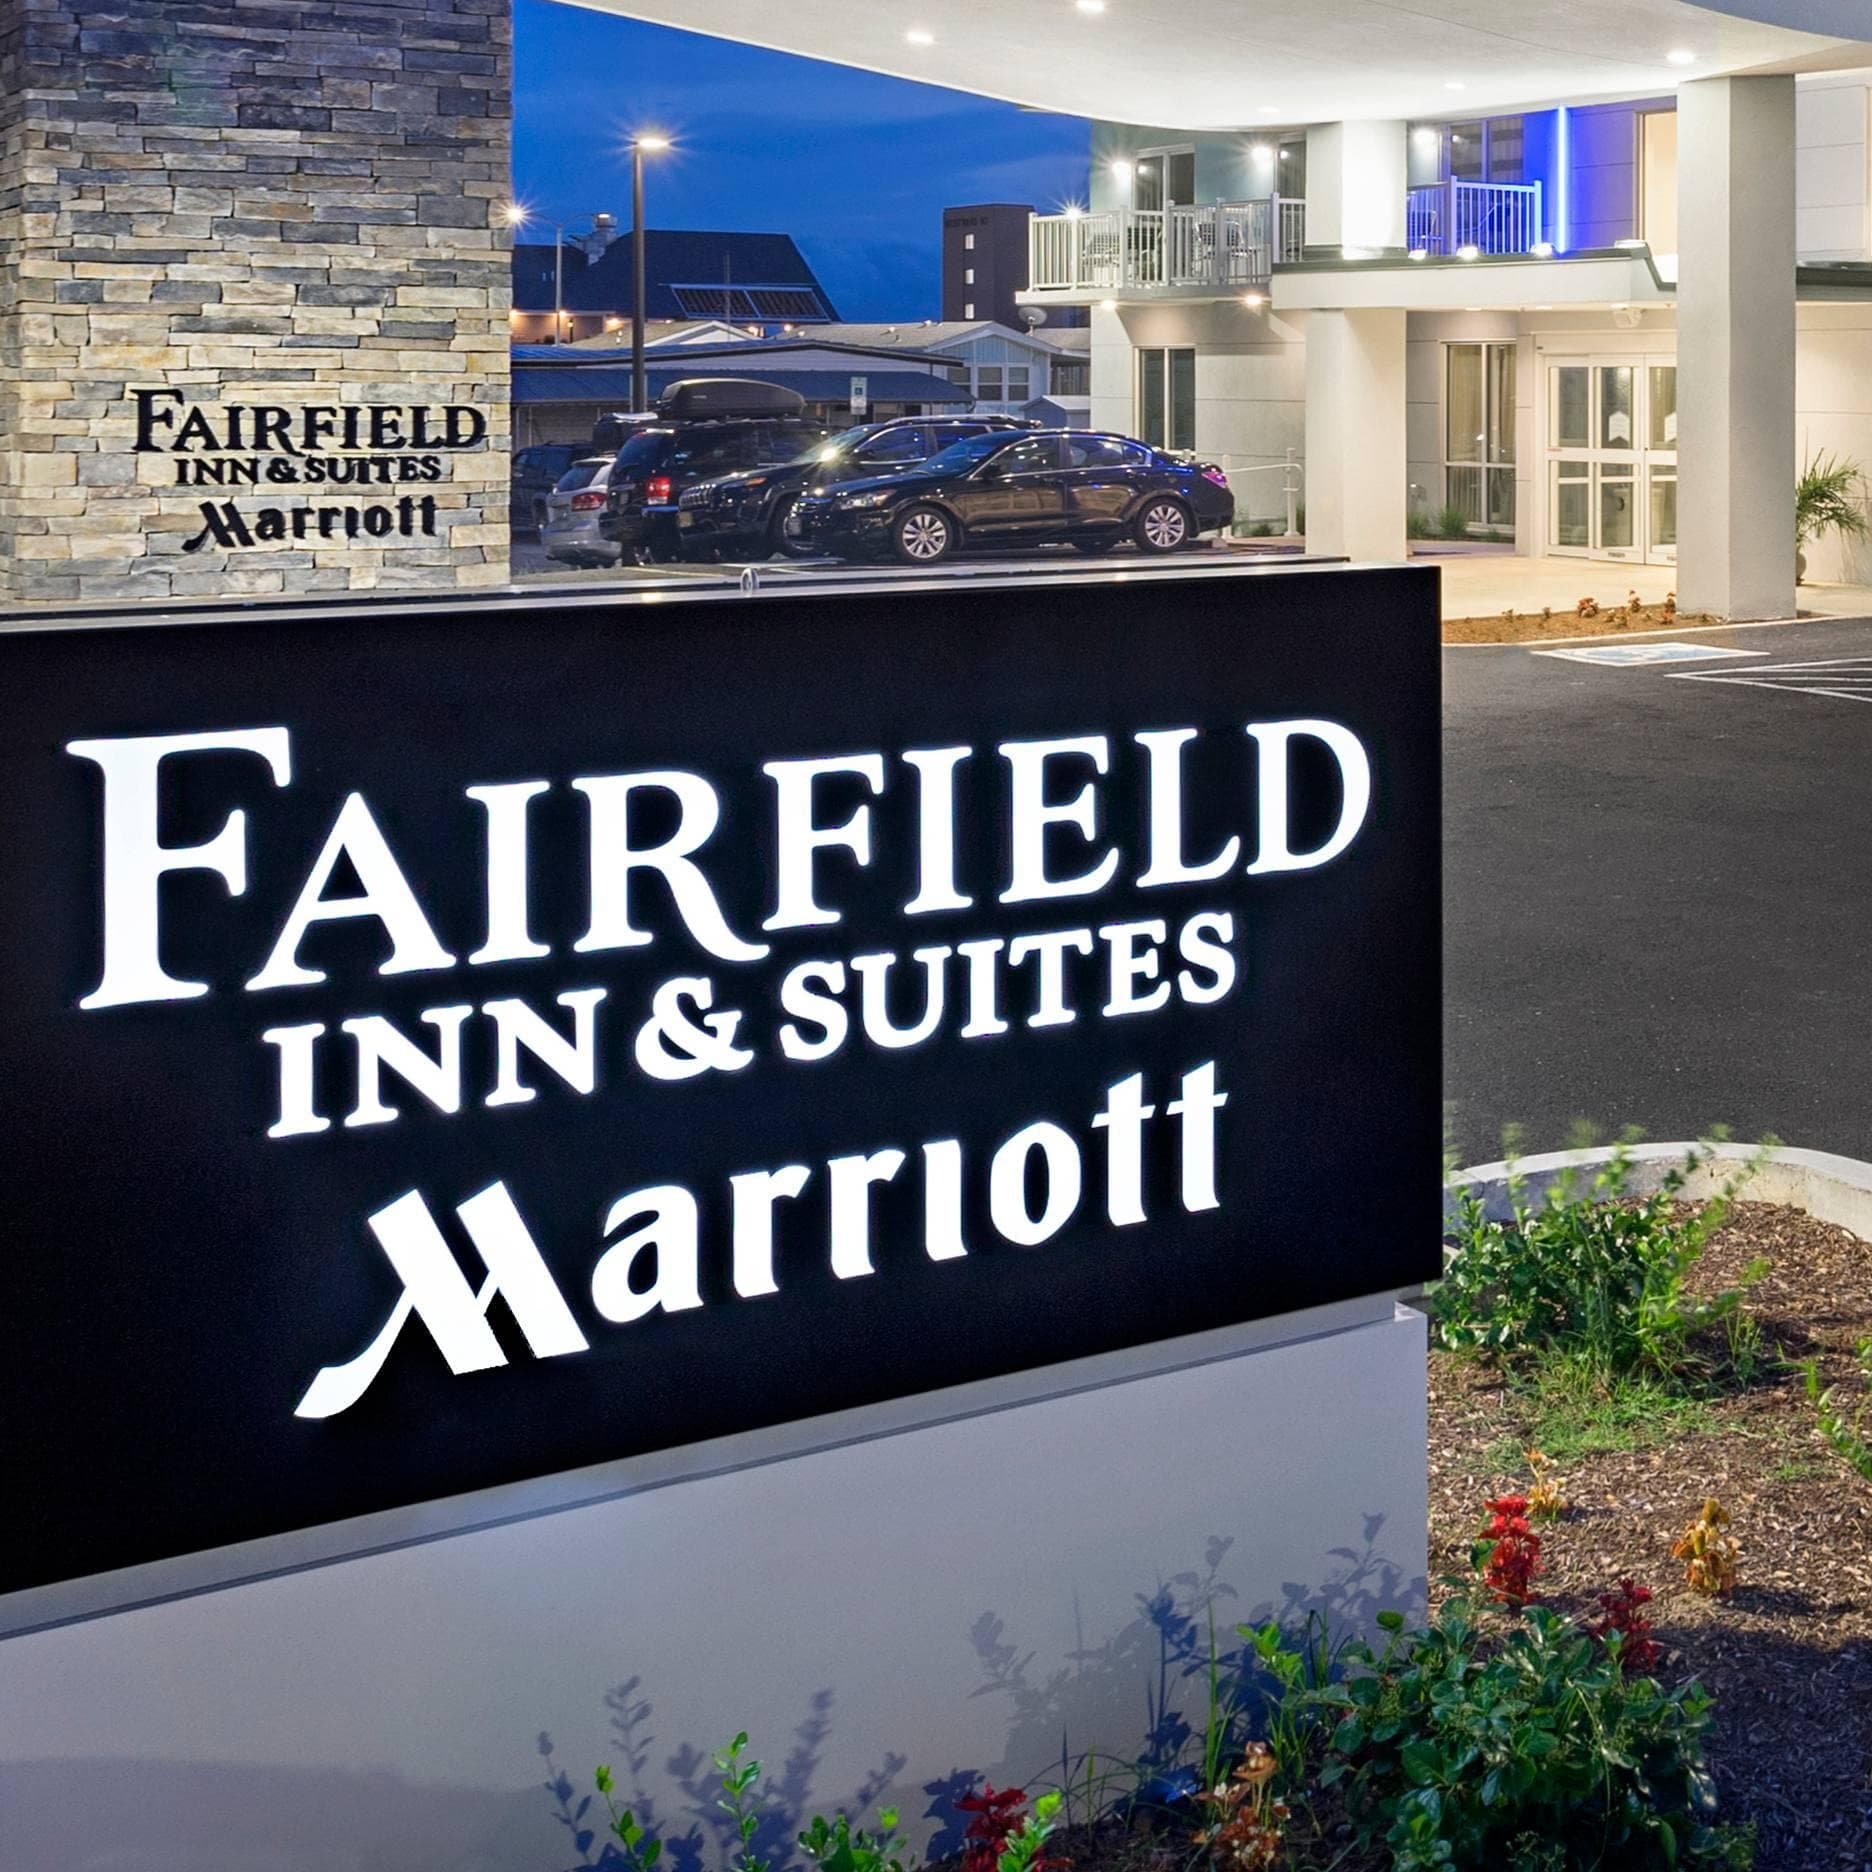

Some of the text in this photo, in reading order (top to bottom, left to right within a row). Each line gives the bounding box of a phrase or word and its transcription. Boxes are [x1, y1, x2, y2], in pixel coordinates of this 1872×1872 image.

[130, 388, 488, 456] FAIRFIELD
[174, 454, 441, 486] INN & SUITES
[182, 494, 437, 551] Marriott
[65, 719, 1372, 1010] FAIRFIELD
[262, 912, 1237, 1138] INN & SUITES
[293, 1060, 1229, 1419] Marriott
